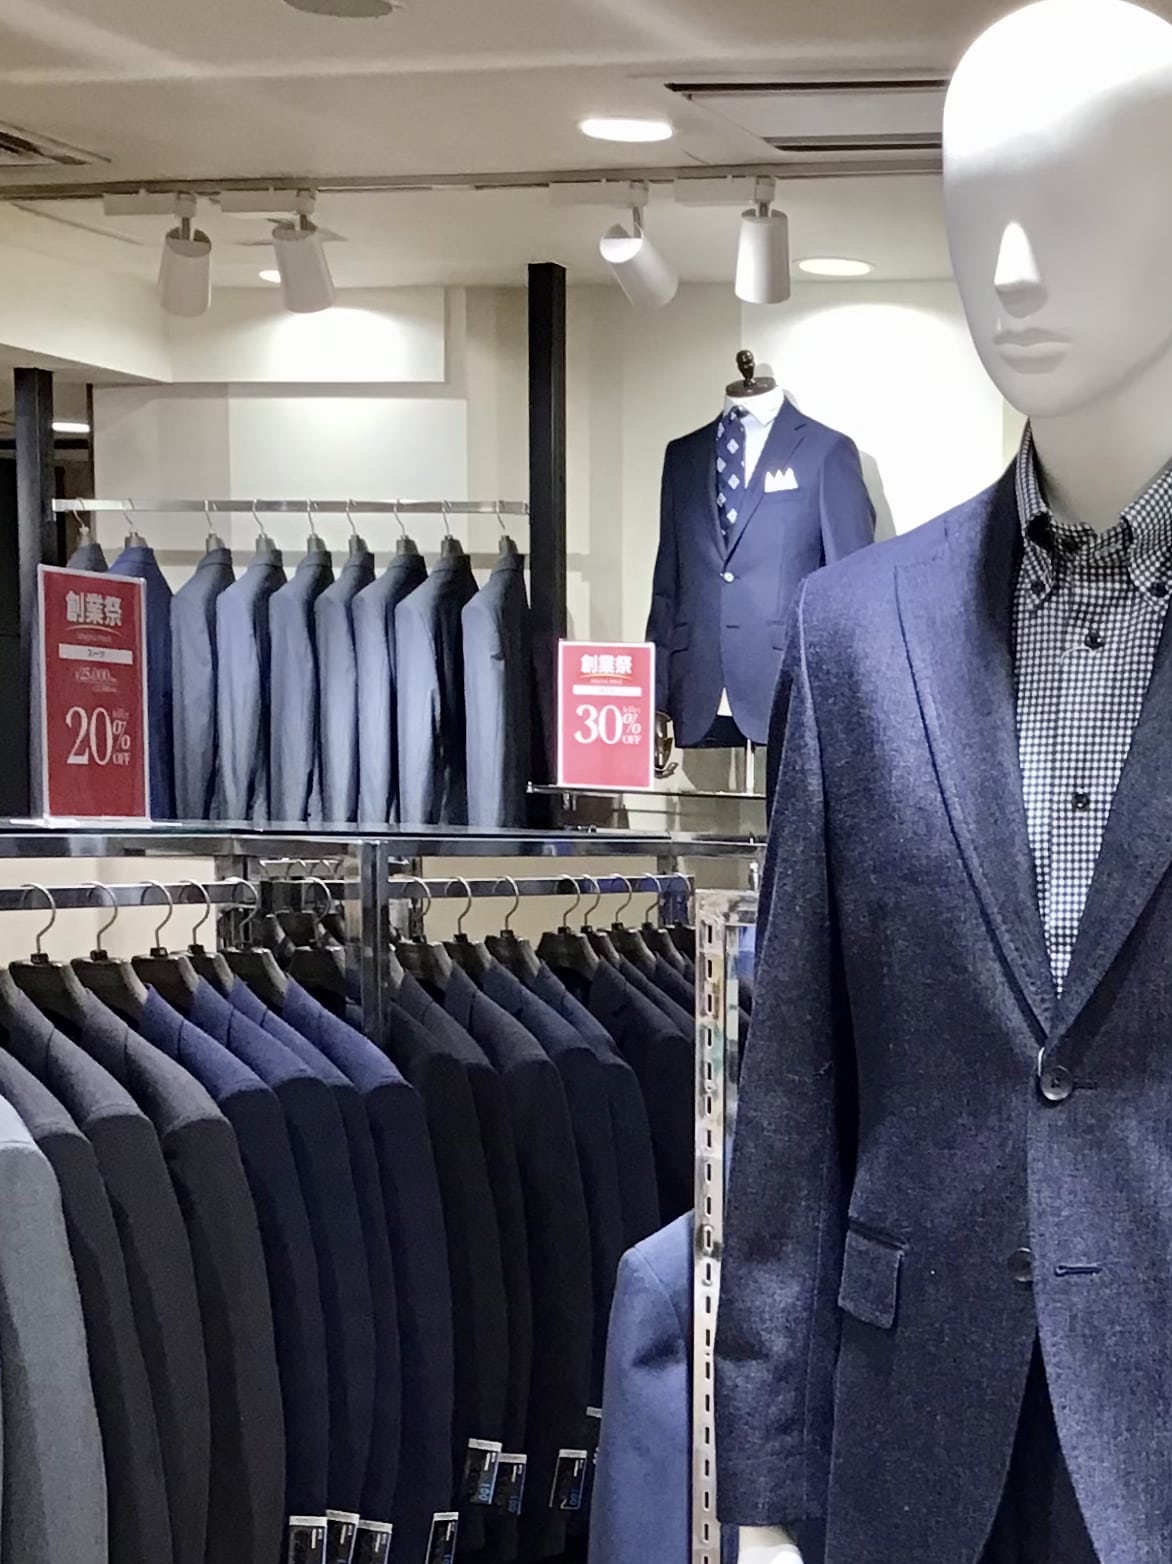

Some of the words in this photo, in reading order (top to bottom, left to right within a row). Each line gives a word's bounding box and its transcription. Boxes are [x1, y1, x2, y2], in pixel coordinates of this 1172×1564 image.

[65, 590, 122, 626] 創業祭
[580, 653, 632, 674] 創業祭
[622, 734, 642, 745] OFF
[112, 752, 130, 766] OFF
